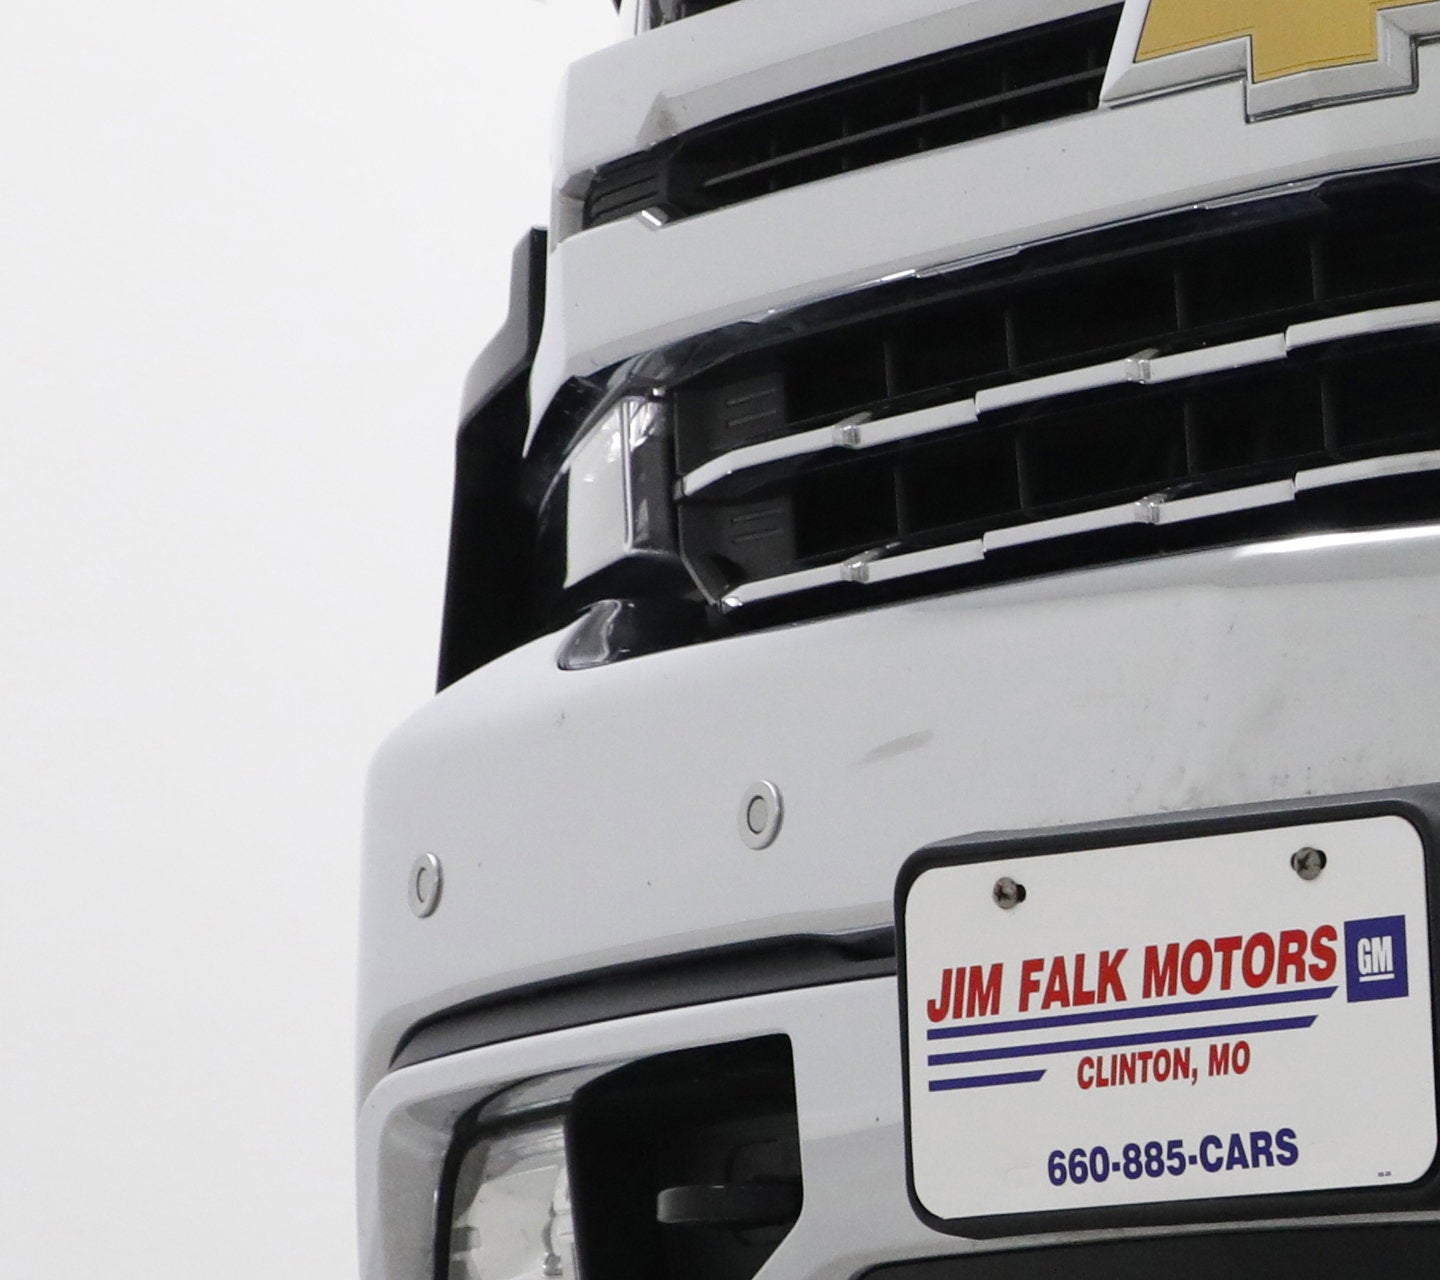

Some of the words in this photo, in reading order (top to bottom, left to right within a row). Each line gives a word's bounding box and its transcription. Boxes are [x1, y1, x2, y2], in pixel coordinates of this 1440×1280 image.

[927, 963, 1004, 1023] JIM
[1019, 949, 1129, 1013] FALK
[1143, 924, 1338, 999] MOTORS
[1357, 935, 1395, 975] GM
[1077, 1048, 1199, 1090] CLINTON,
[1208, 1041, 1251, 1077] MO
[1047, 1129, 1299, 1187] 660-885-CARS
